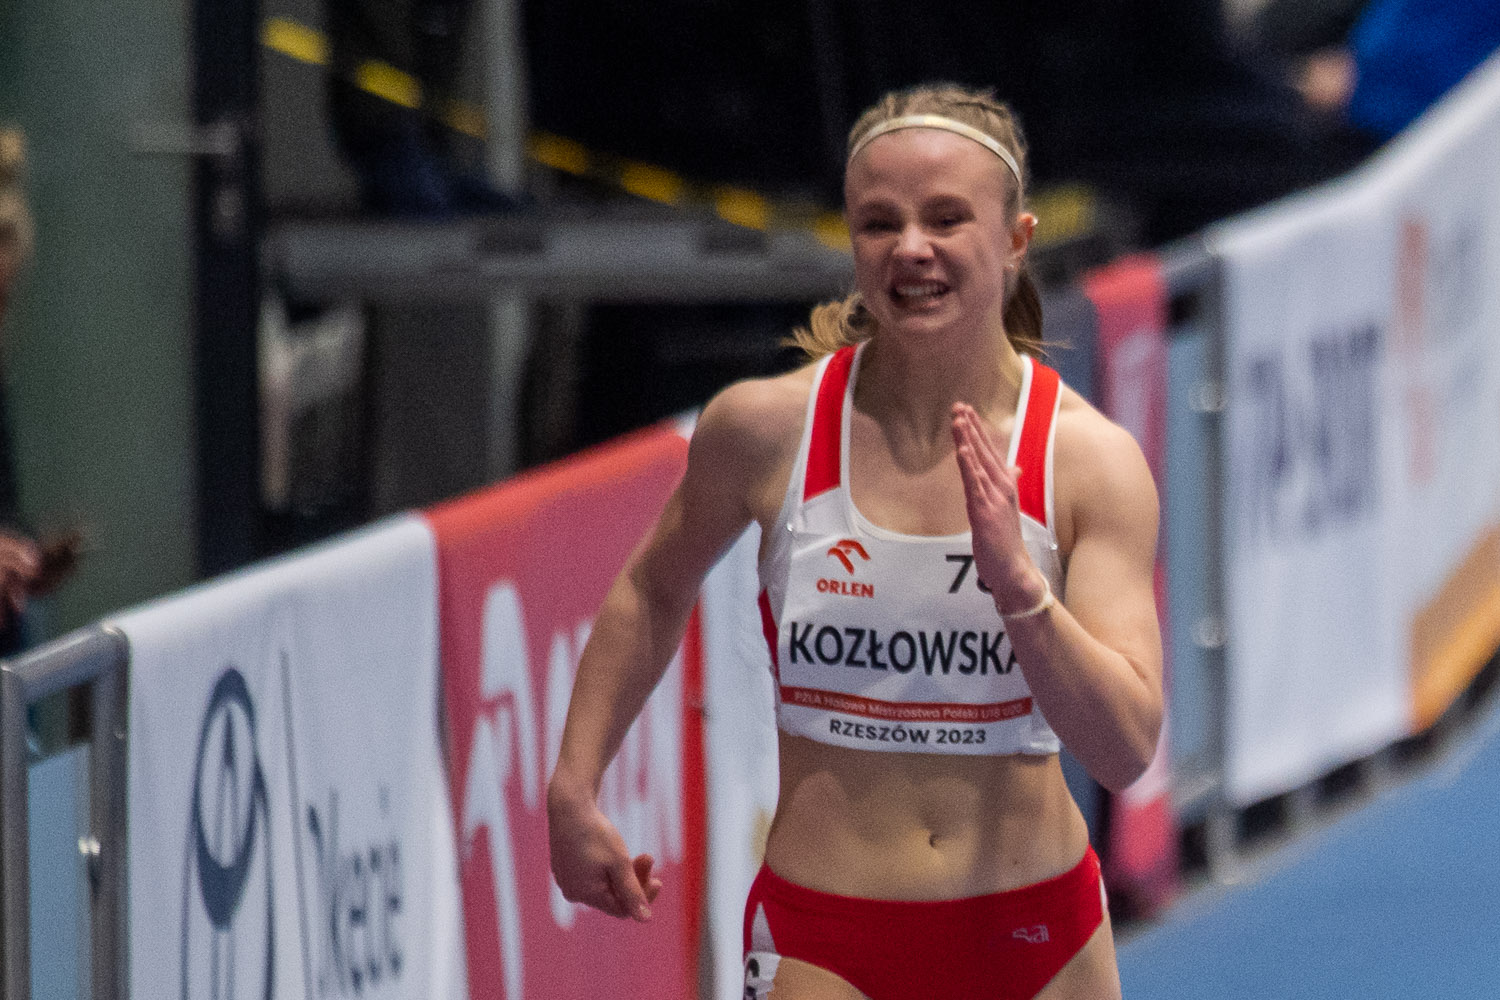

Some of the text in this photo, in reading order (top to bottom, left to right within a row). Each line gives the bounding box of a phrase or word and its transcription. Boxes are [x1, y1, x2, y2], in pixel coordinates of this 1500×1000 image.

[945, 554, 993, 595] 7
[816, 578, 874, 599] ORLEN
[829, 718, 987, 745] RZESZÓW 2023
